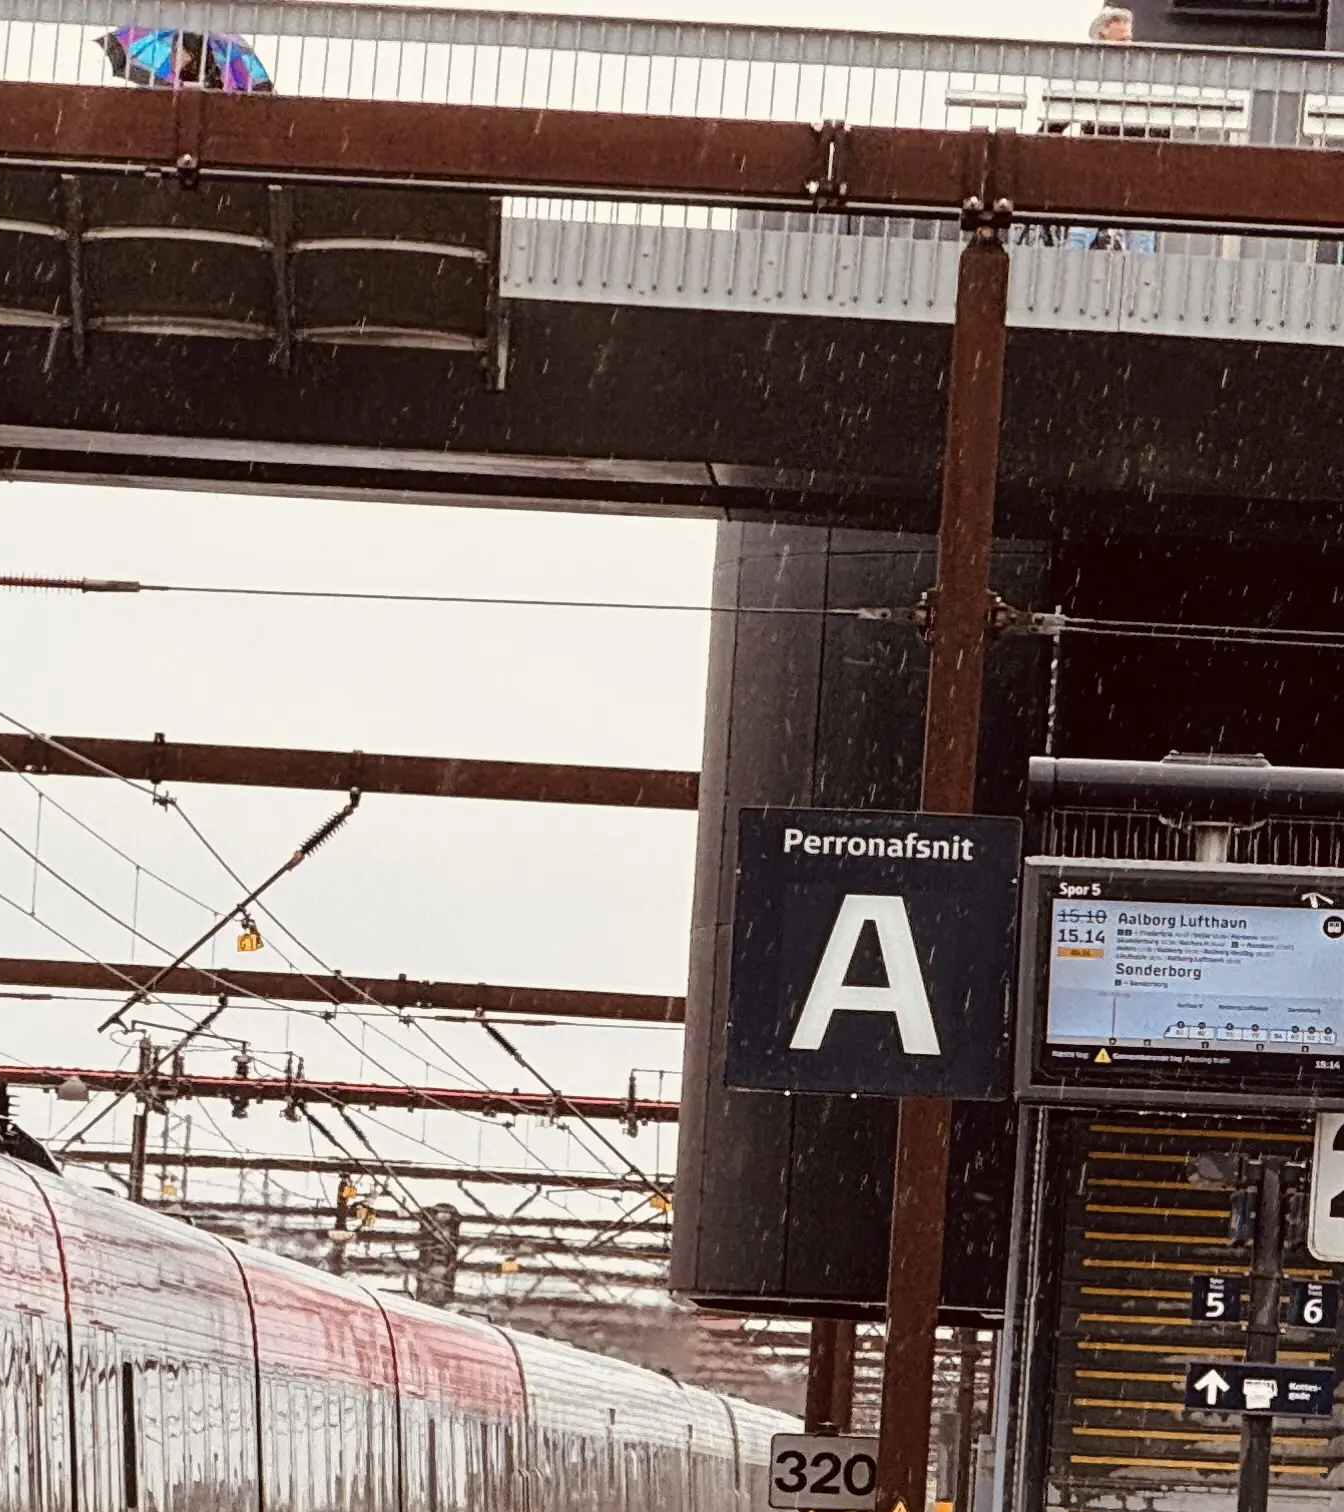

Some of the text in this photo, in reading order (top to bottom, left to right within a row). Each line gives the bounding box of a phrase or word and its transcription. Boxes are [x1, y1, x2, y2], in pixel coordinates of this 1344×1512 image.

[784, 828, 975, 862] Perronafsnit
[1059, 883, 1102, 897] Spor 5
[1118, 912, 1177, 929] Aalborg
[1180, 914, 1247, 930] Lufthavn
[1057, 928, 1106, 944] 15.14
[789, 894, 942, 1057] A
[1205, 1292, 1225, 1318] 5
[1303, 1298, 1323, 1324] 6
[774, 1451, 877, 1497] 320
